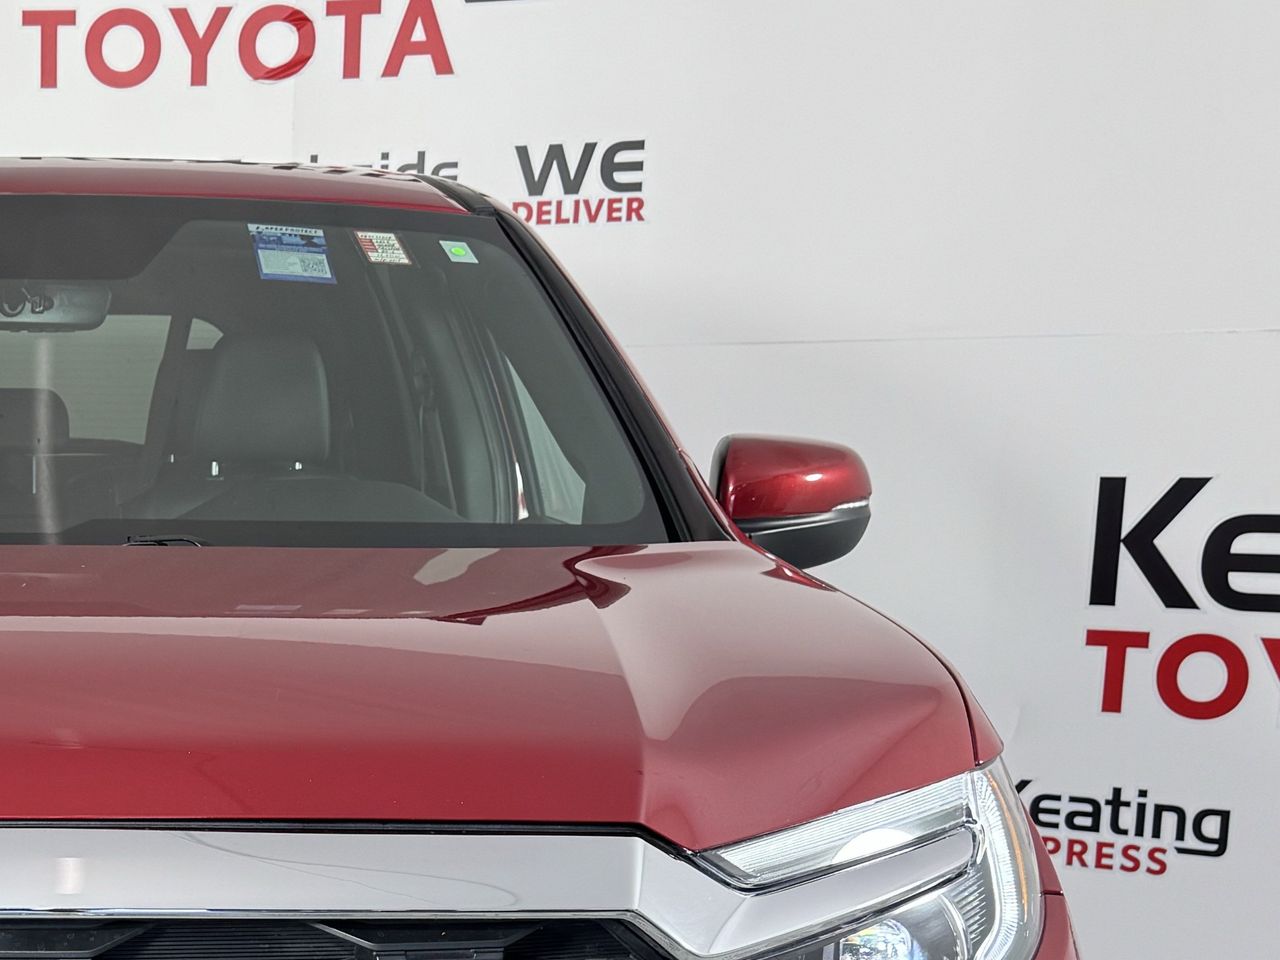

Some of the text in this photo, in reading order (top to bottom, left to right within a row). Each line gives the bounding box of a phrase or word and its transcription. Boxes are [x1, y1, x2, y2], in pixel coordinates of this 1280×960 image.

[22, 0, 455, 89] TOYOTA
[515, 140, 645, 197] WE
[512, 197, 645, 225] DELIVER
[1084, 628, 1280, 720] TO
[1014, 779, 1231, 857] eating
